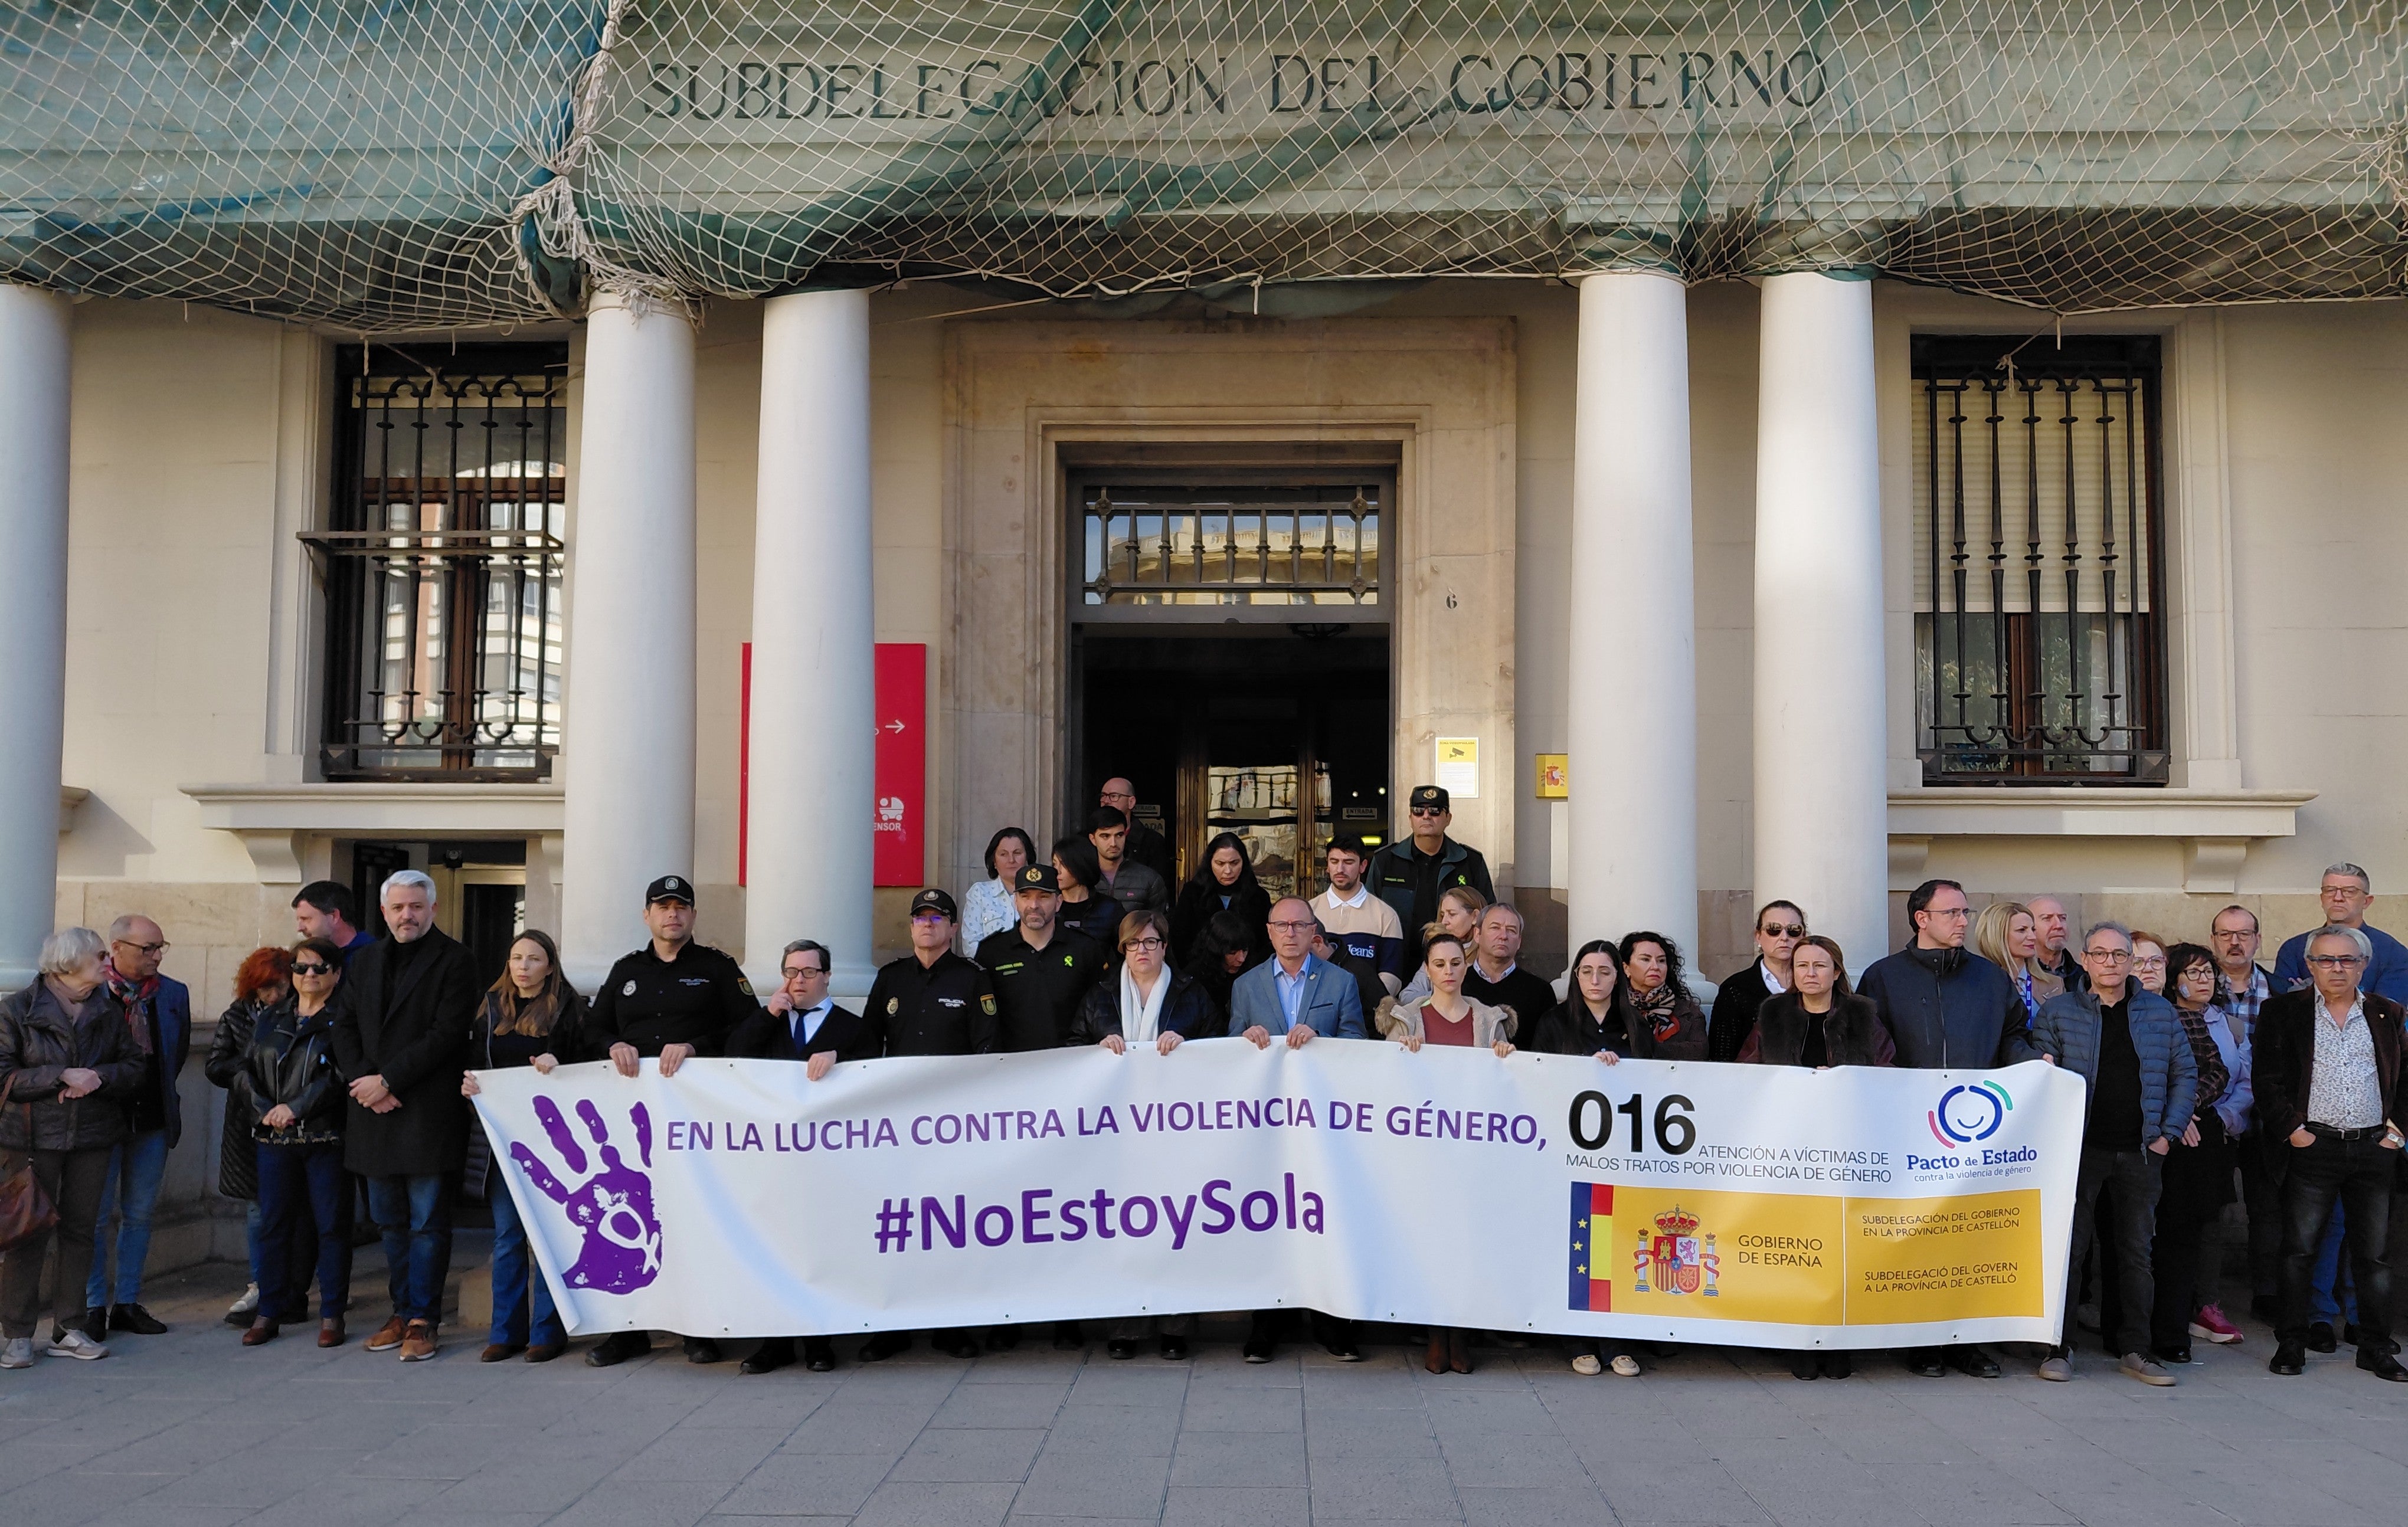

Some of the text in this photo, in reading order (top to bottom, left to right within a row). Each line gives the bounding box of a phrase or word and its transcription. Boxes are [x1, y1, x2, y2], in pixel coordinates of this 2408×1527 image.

[1270, 52, 1402, 113] DEL
[1450, 50, 1827, 114] GOBIERNO
[1445, 594, 1457, 609] 6
[668, 1097, 1547, 1152] EN LA LUCHA CONTRA LA VIOLENCIA DE GÉNERO,
[1568, 1090, 1696, 1155] 016
[1699, 1145, 1889, 1165] ATENCIÓN A VÍCTIMAS DE
[1906, 1146, 2037, 1169] Pacto de Estado
[1566, 1154, 1892, 1183] MALOS TRATOS POR VIOLENCIA DE GÉNERO
[1956, 1169, 1992, 1178] violencia
[2005, 1166, 2031, 1177] género
[874, 1172, 1324, 1253] #NoEstoySola
[1862, 1207, 2020, 1224] SUBDELEGACIÓN DEL GOBIERNO
[1864, 1218, 2019, 1237] EN LA PROVINCIA DE CASTELLÓN
[1739, 1235, 1822, 1250] GOBIERNO
[1739, 1251, 1823, 1268] DE ESPAÑA
[1865, 1262, 2017, 1280] SUBDELEGACIÓ DEL GOVERN
[1876, 1284, 1889, 1292] LA
[1892, 1280, 1948, 1292] PROVÍNCIA
[1951, 1279, 1962, 1288] DE
[1966, 1273, 2016, 1286] CASTELLÓ
